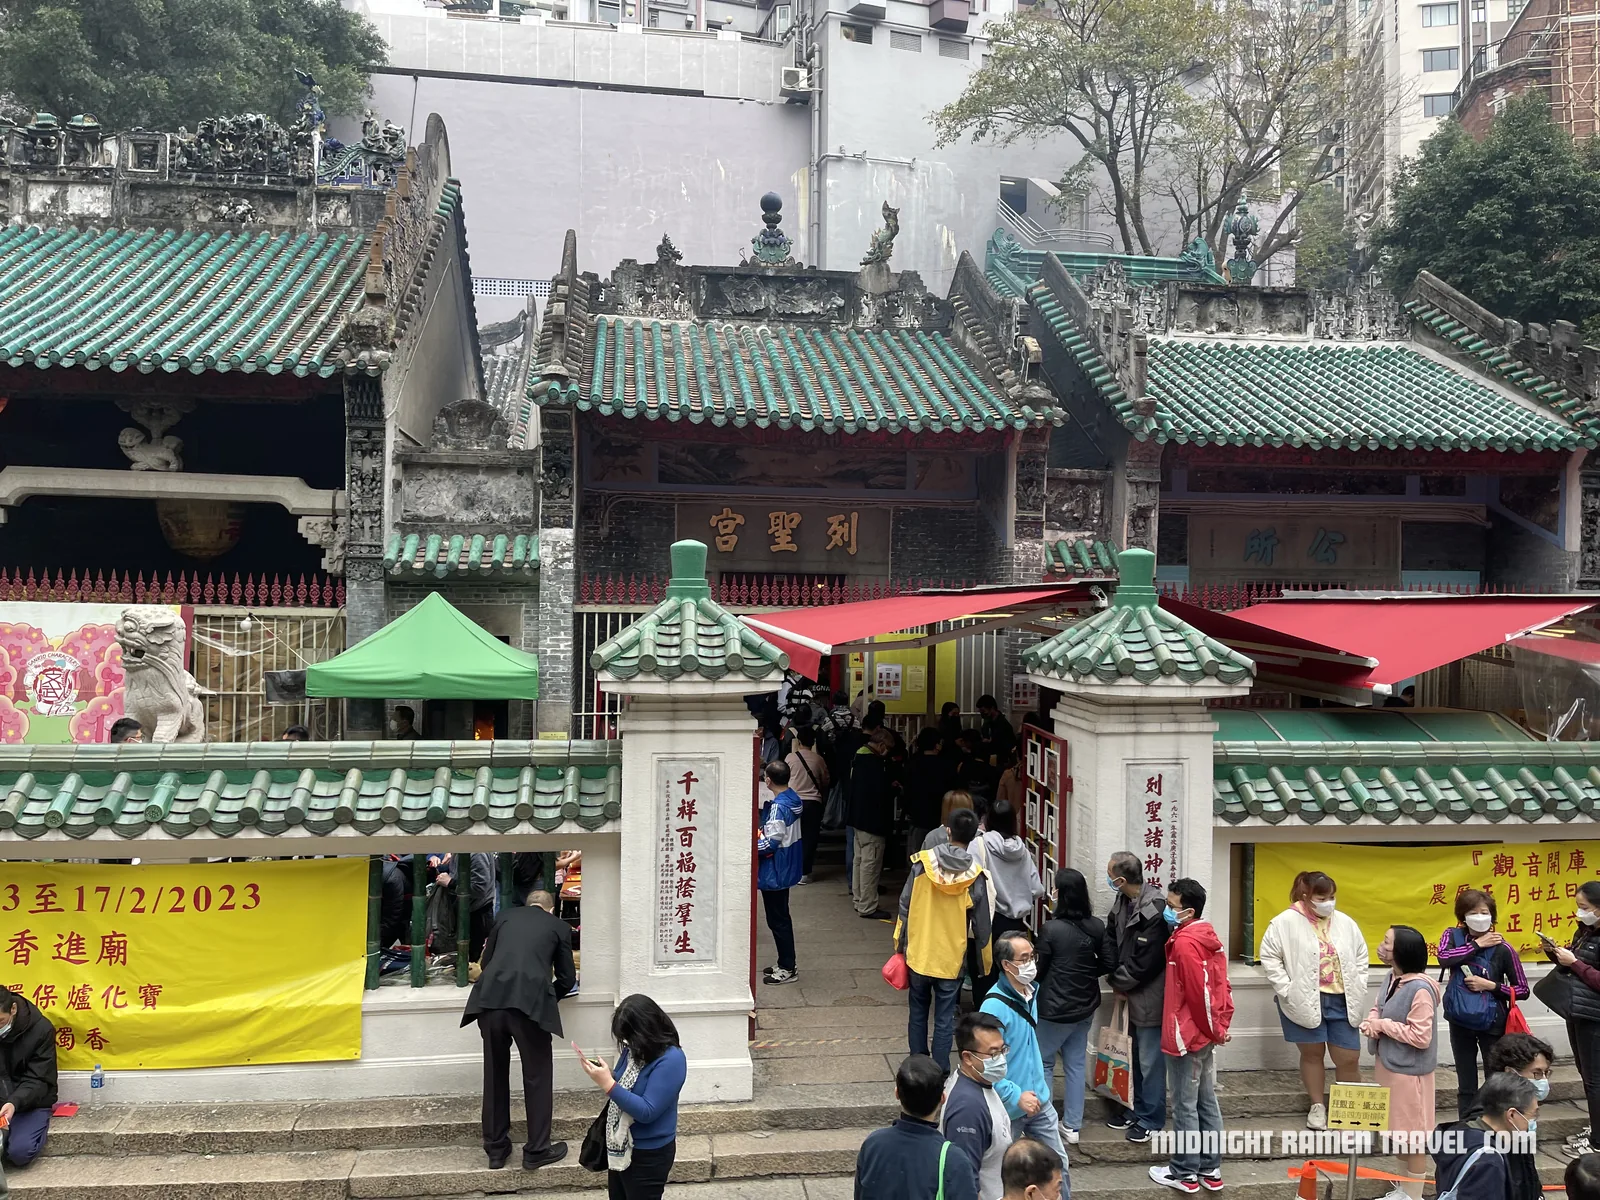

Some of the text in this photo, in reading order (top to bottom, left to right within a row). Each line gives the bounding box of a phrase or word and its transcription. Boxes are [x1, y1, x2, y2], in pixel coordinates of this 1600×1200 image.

[708, 507, 859, 556] 列聖宮
[1243, 525, 1346, 567] 公所
[5, 928, 128, 967] 香進廟
